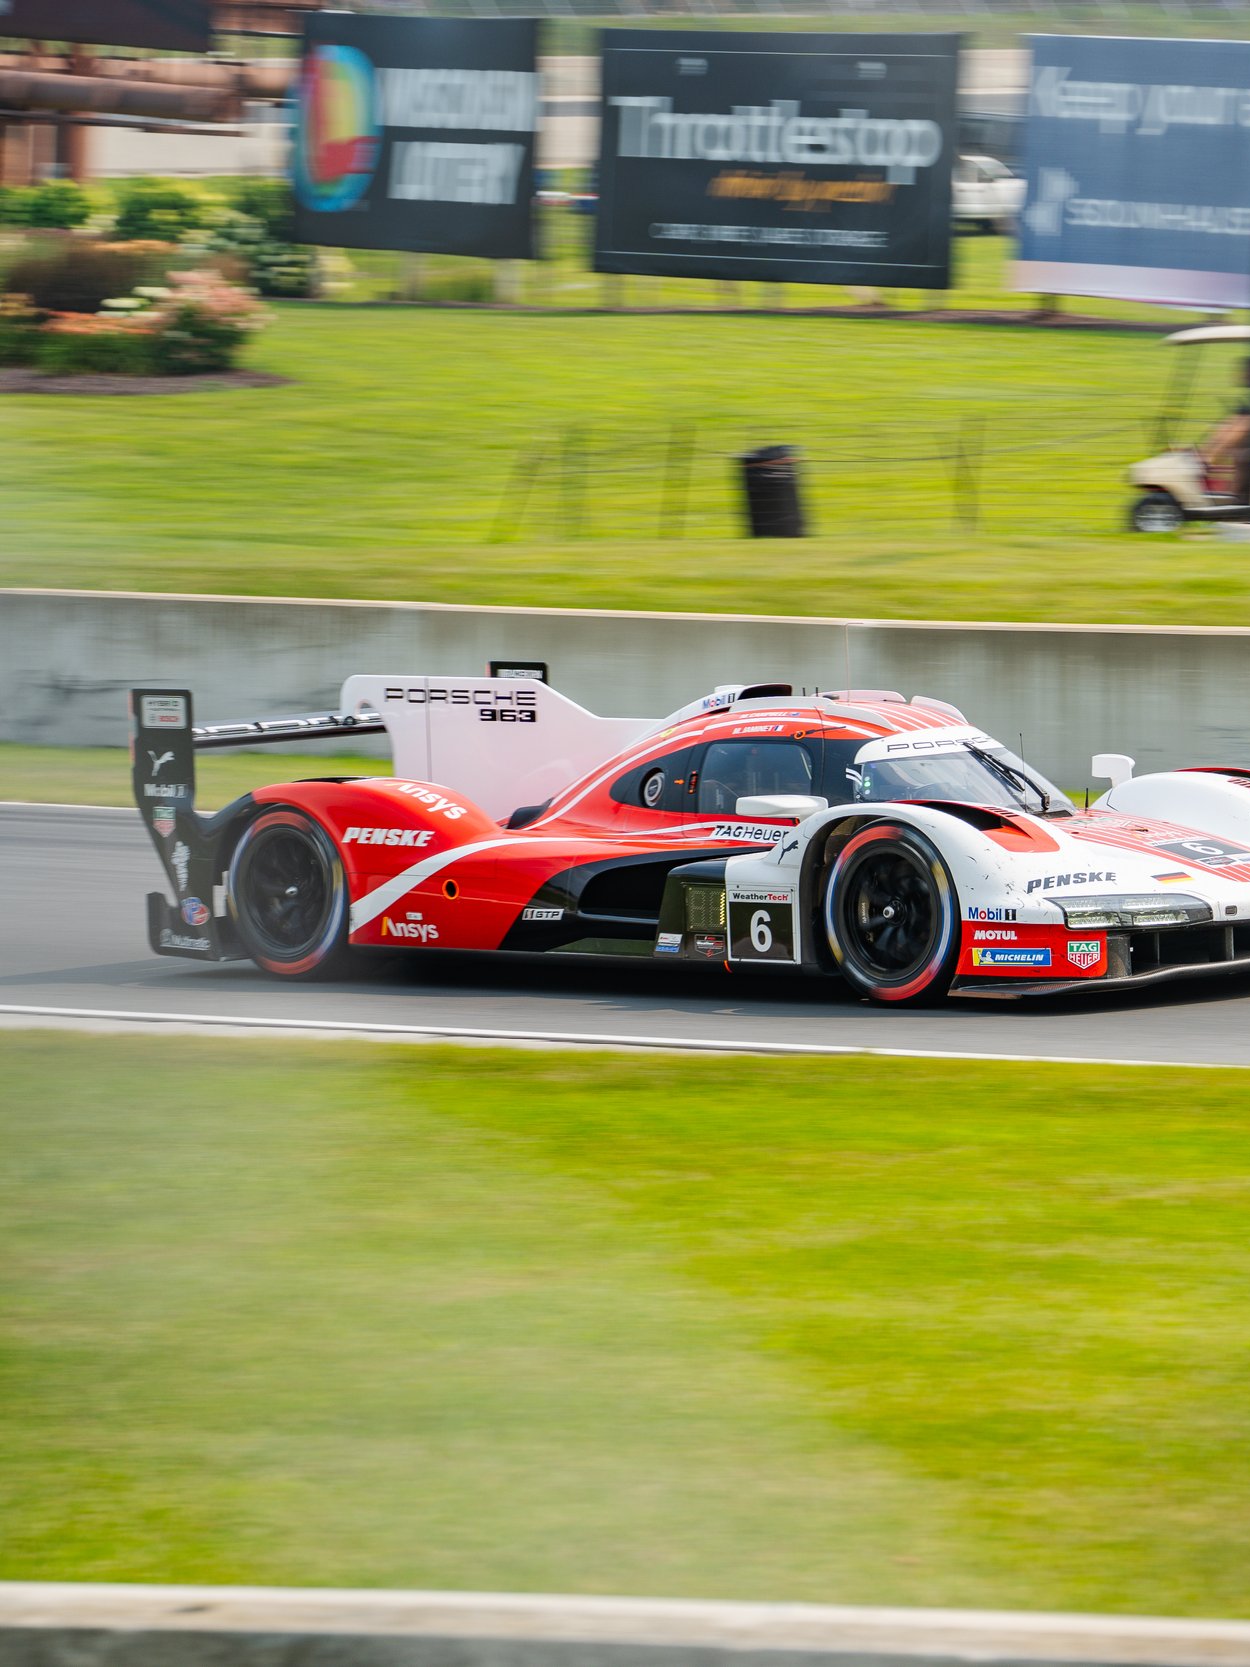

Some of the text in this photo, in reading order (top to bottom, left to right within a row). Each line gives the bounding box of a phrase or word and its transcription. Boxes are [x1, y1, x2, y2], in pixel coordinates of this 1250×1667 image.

[385, 688, 536, 706] PORSCHE
[480, 709, 536, 722] 963
[385, 783, 468, 819] Ansys
[342, 827, 435, 847] PENSKE
[1181, 842, 1224, 855] 6
[1026, 871, 1117, 894] PENSKE
[732, 892, 788, 901] WeatherTech
[968, 906, 1016, 921] Mobil 1
[381, 916, 439, 942] Ansys
[750, 909, 773, 952] 6
[973, 930, 1018, 940] MOTUL
[1070, 943, 1097, 952] TAG
[994, 953, 1044, 961] MICHELIN
[1069, 953, 1099, 967] HEUER
